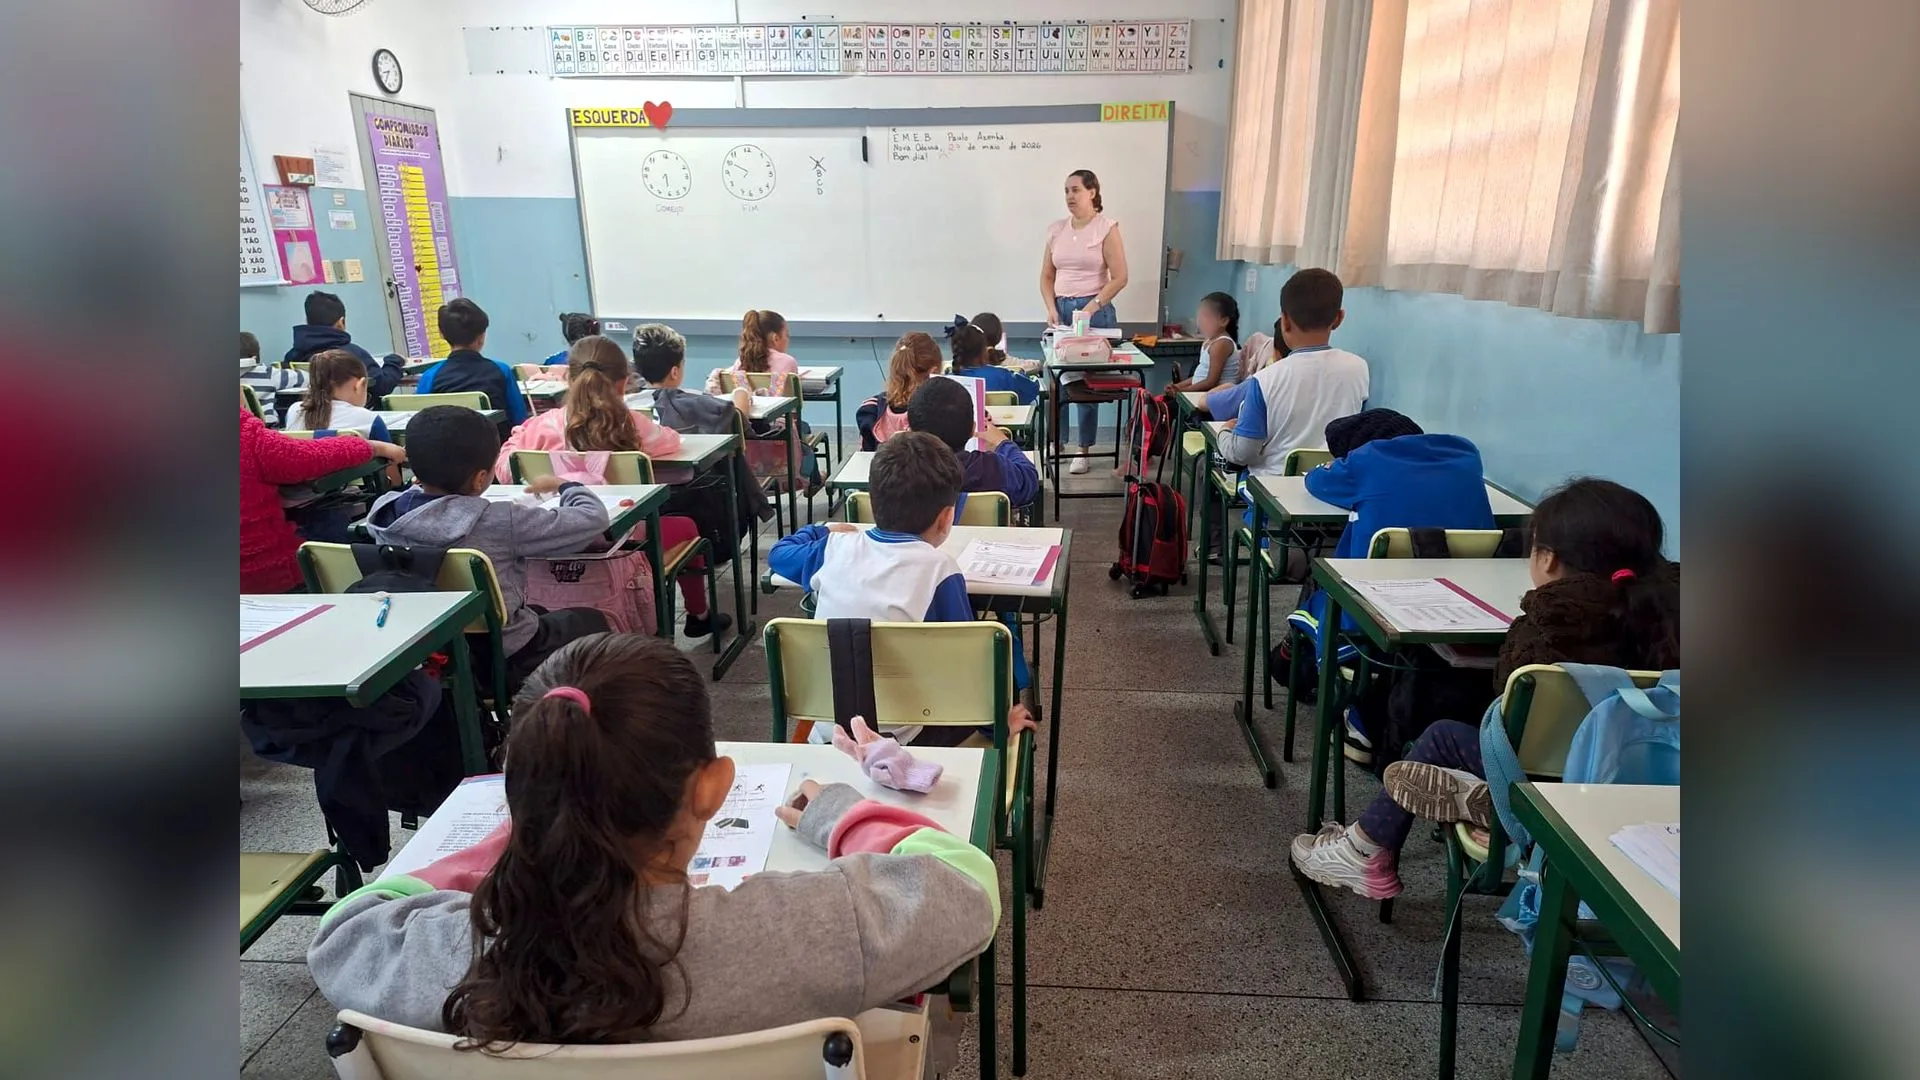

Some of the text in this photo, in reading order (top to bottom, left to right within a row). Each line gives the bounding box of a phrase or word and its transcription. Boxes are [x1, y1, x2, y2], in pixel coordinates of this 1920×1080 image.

[553, 31, 560, 41] A
[625, 32, 632, 40] D
[770, 29, 775, 38] J
[795, 29, 802, 38] K
[819, 29, 825, 38] L
[844, 29, 850, 38] M
[869, 28, 875, 38] N
[893, 28, 900, 38] O
[919, 28, 925, 38] P
[943, 28, 950, 39] Q
[968, 28, 975, 38] R
[993, 28, 1000, 39] S
[1018, 28, 1024, 38] T
[1043, 28, 1050, 39] U
[1068, 28, 1075, 38] V
[1094, 28, 1102, 37] W
[1118, 28, 1125, 37] X
[1144, 27, 1151, 37] Y
[1170, 27, 1177, 36] Z
[577, 32, 584, 41] B
[556, 52, 562, 60] A
[579, 52, 586, 61] B
[603, 52, 610, 61] C
[627, 52, 633, 61] D
[651, 51, 657, 60] E
[675, 51, 680, 60] F
[698, 50, 705, 60] G
[723, 50, 729, 59] H
[772, 50, 777, 59] J
[796, 50, 802, 59] K
[821, 50, 826, 59] L
[845, 50, 851, 58] M
[869, 50, 876, 59] N
[894, 50, 900, 59] O
[919, 50, 924, 58] P
[943, 50, 950, 59] Q
[968, 50, 974, 58] R
[993, 50, 999, 59] S
[1018, 50, 1024, 58] T
[1043, 50, 1049, 59] U
[1068, 50, 1074, 58] V
[1118, 49, 1124, 58] X
[1144, 49, 1149, 58] Y
[1169, 48, 1175, 58] Z
[573, 110, 646, 124] ESQUERDA
[1104, 104, 1167, 121] DIREITA
[374, 118, 428, 137] COMPROMISSOS
[948, 132, 968, 141] Paulo
[1009, 142, 1016, 150] de
[893, 152, 909, 161] Bom
